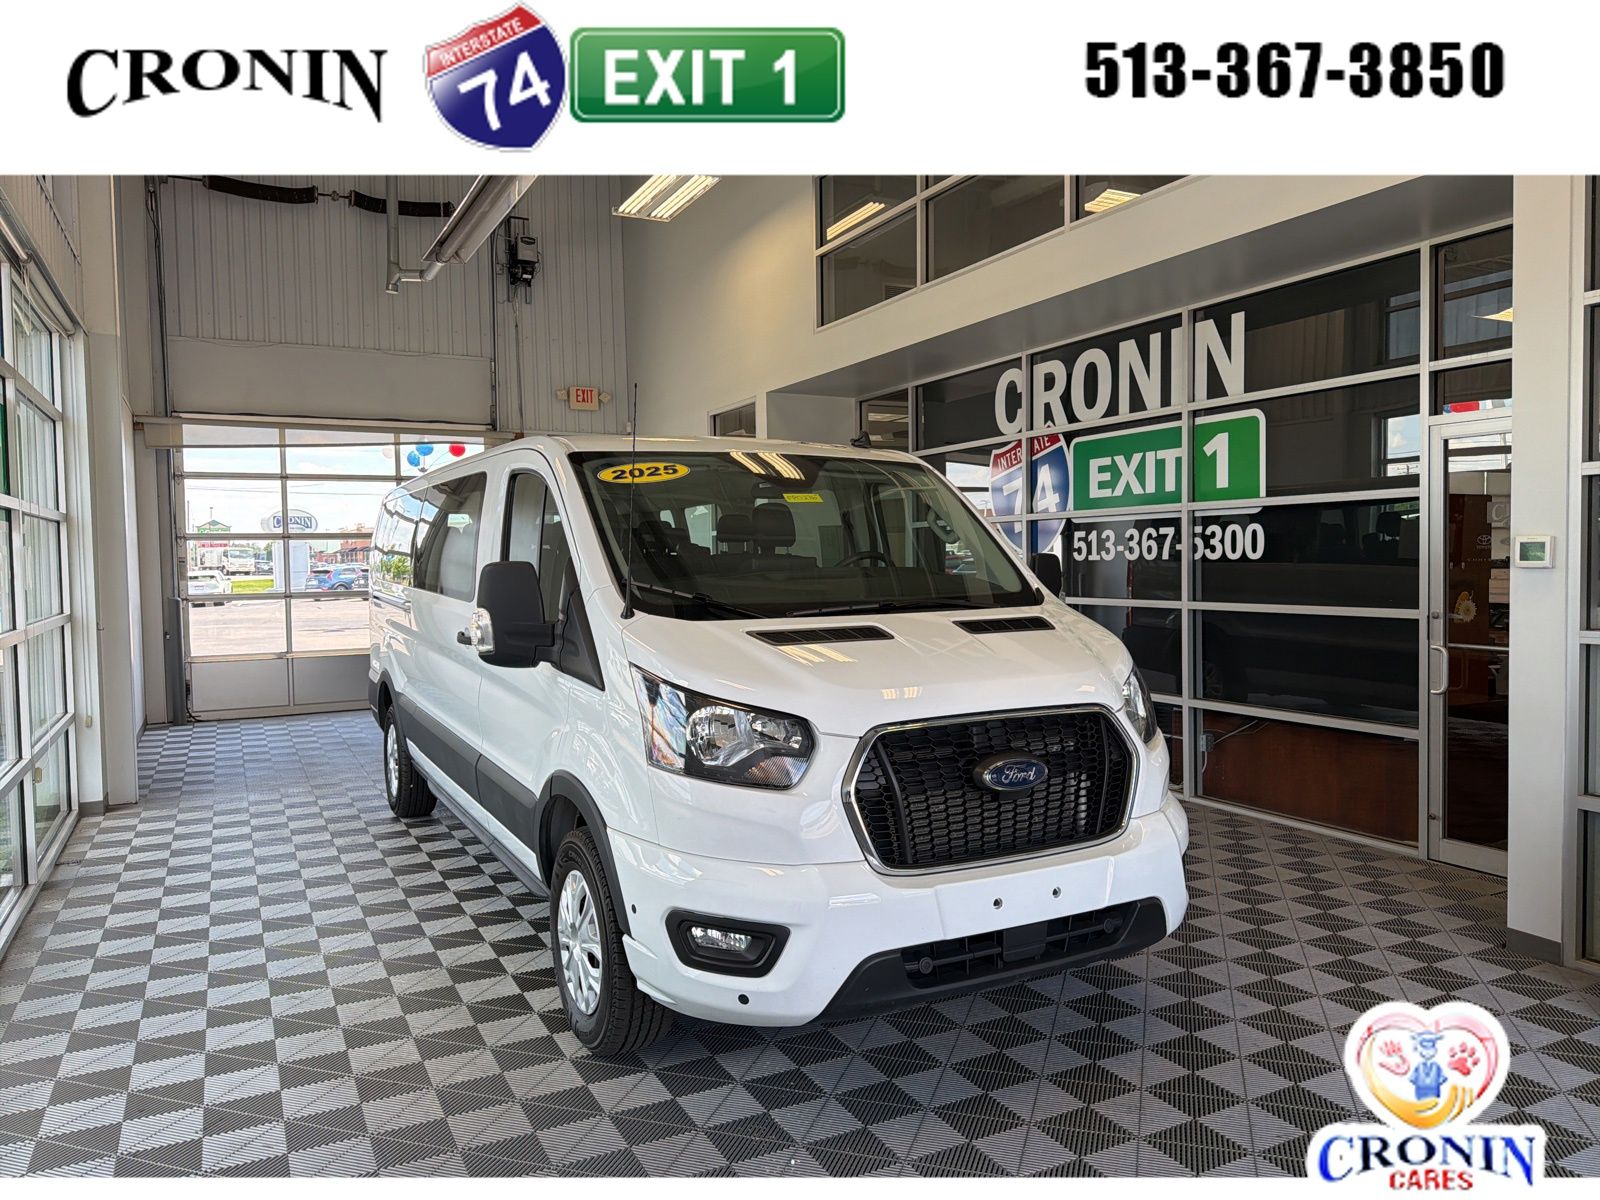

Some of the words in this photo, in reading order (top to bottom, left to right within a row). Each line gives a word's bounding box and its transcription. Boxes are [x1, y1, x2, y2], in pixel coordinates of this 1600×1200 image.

[994, 310, 1246, 436] CRONIN
[575, 387, 594, 404] EXIT
[997, 435, 1052, 472] INTERATE
[1088, 447, 1183, 499] EXIT
[1202, 431, 1229, 489] 1
[611, 464, 679, 481] 2025
[1002, 463, 1060, 534] 74
[273, 516, 312, 528] CONIN
[1072, 522, 1266, 562] 513-367-5300
[1001, 764, 1036, 784] Ford
